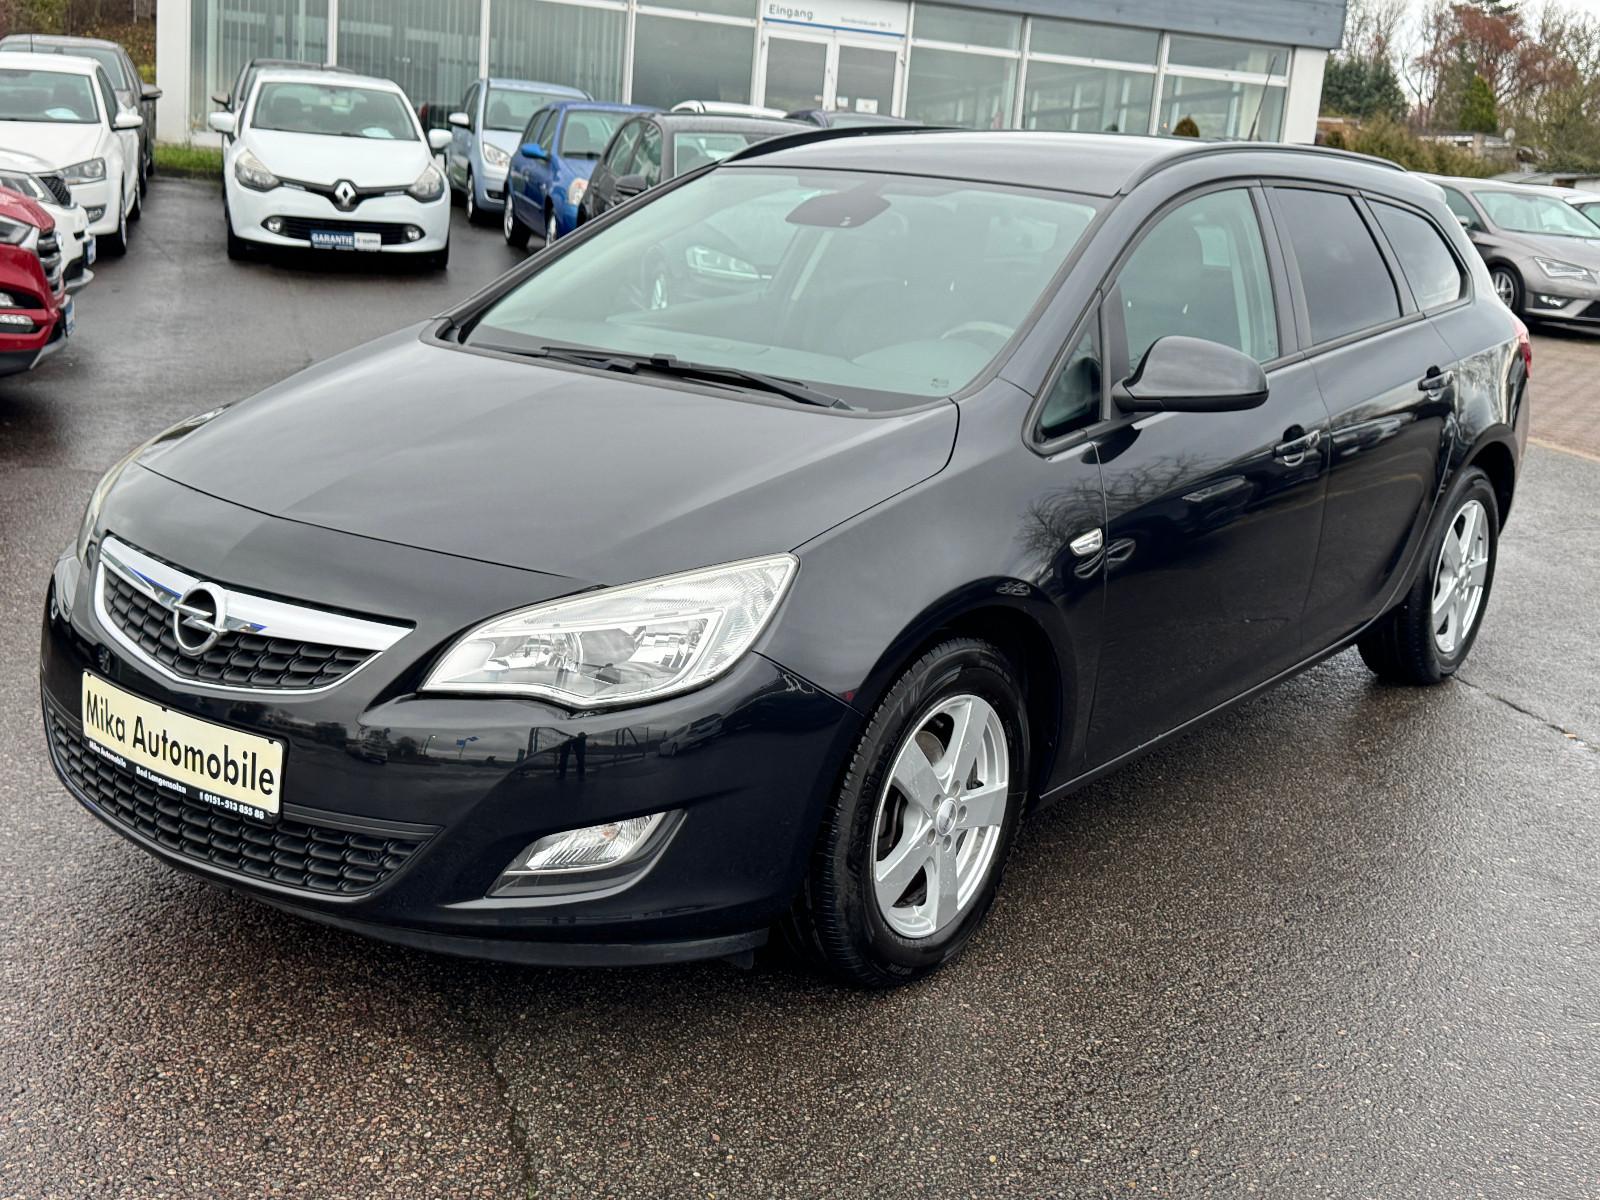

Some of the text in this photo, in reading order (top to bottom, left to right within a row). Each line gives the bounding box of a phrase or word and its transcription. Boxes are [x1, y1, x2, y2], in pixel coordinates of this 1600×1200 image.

[768, 4, 814, 20] Eingang
[311, 233, 353, 245] GARANTIE
[86, 689, 275, 796] Mika Automobile
